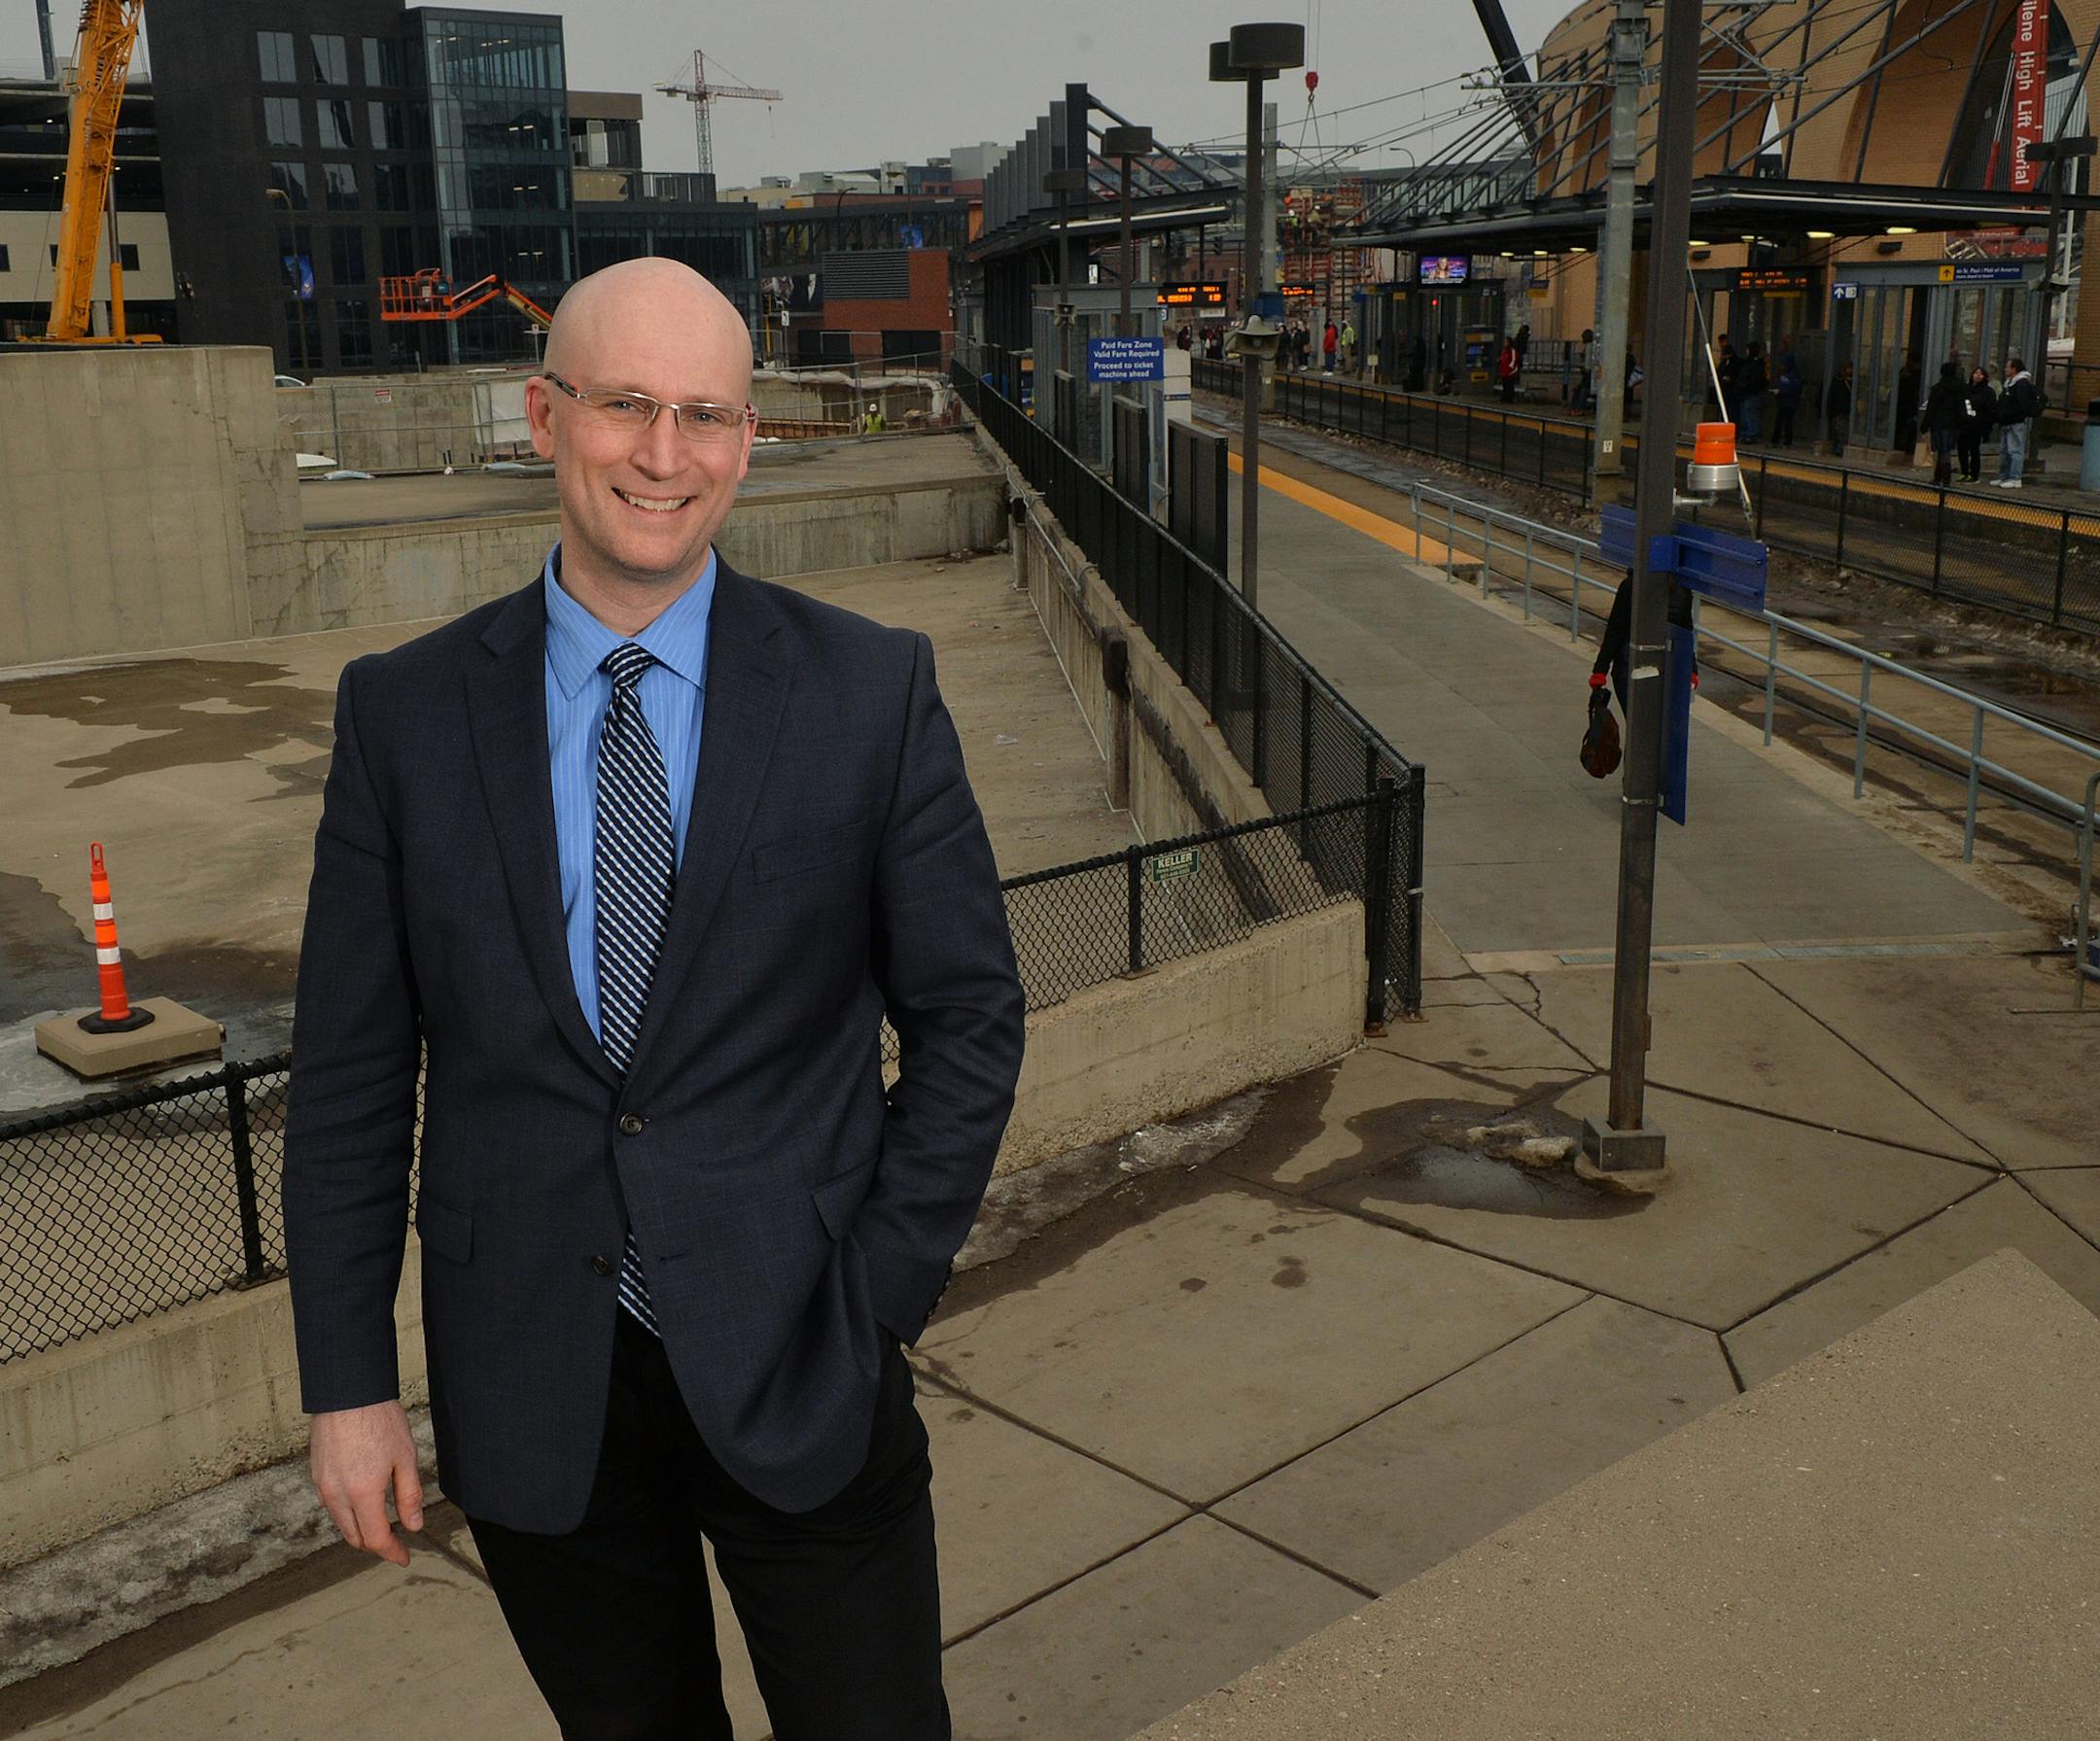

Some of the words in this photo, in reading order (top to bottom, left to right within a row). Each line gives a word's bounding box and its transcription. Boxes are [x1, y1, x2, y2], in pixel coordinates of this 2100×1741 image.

[2015, 51, 2036, 91] High
[2017, 99, 2033, 128] Lift
[2014, 136, 2031, 185] Aerial
[1117, 340, 1133, 349] Fare
[1158, 853, 1193, 868] KELLER
